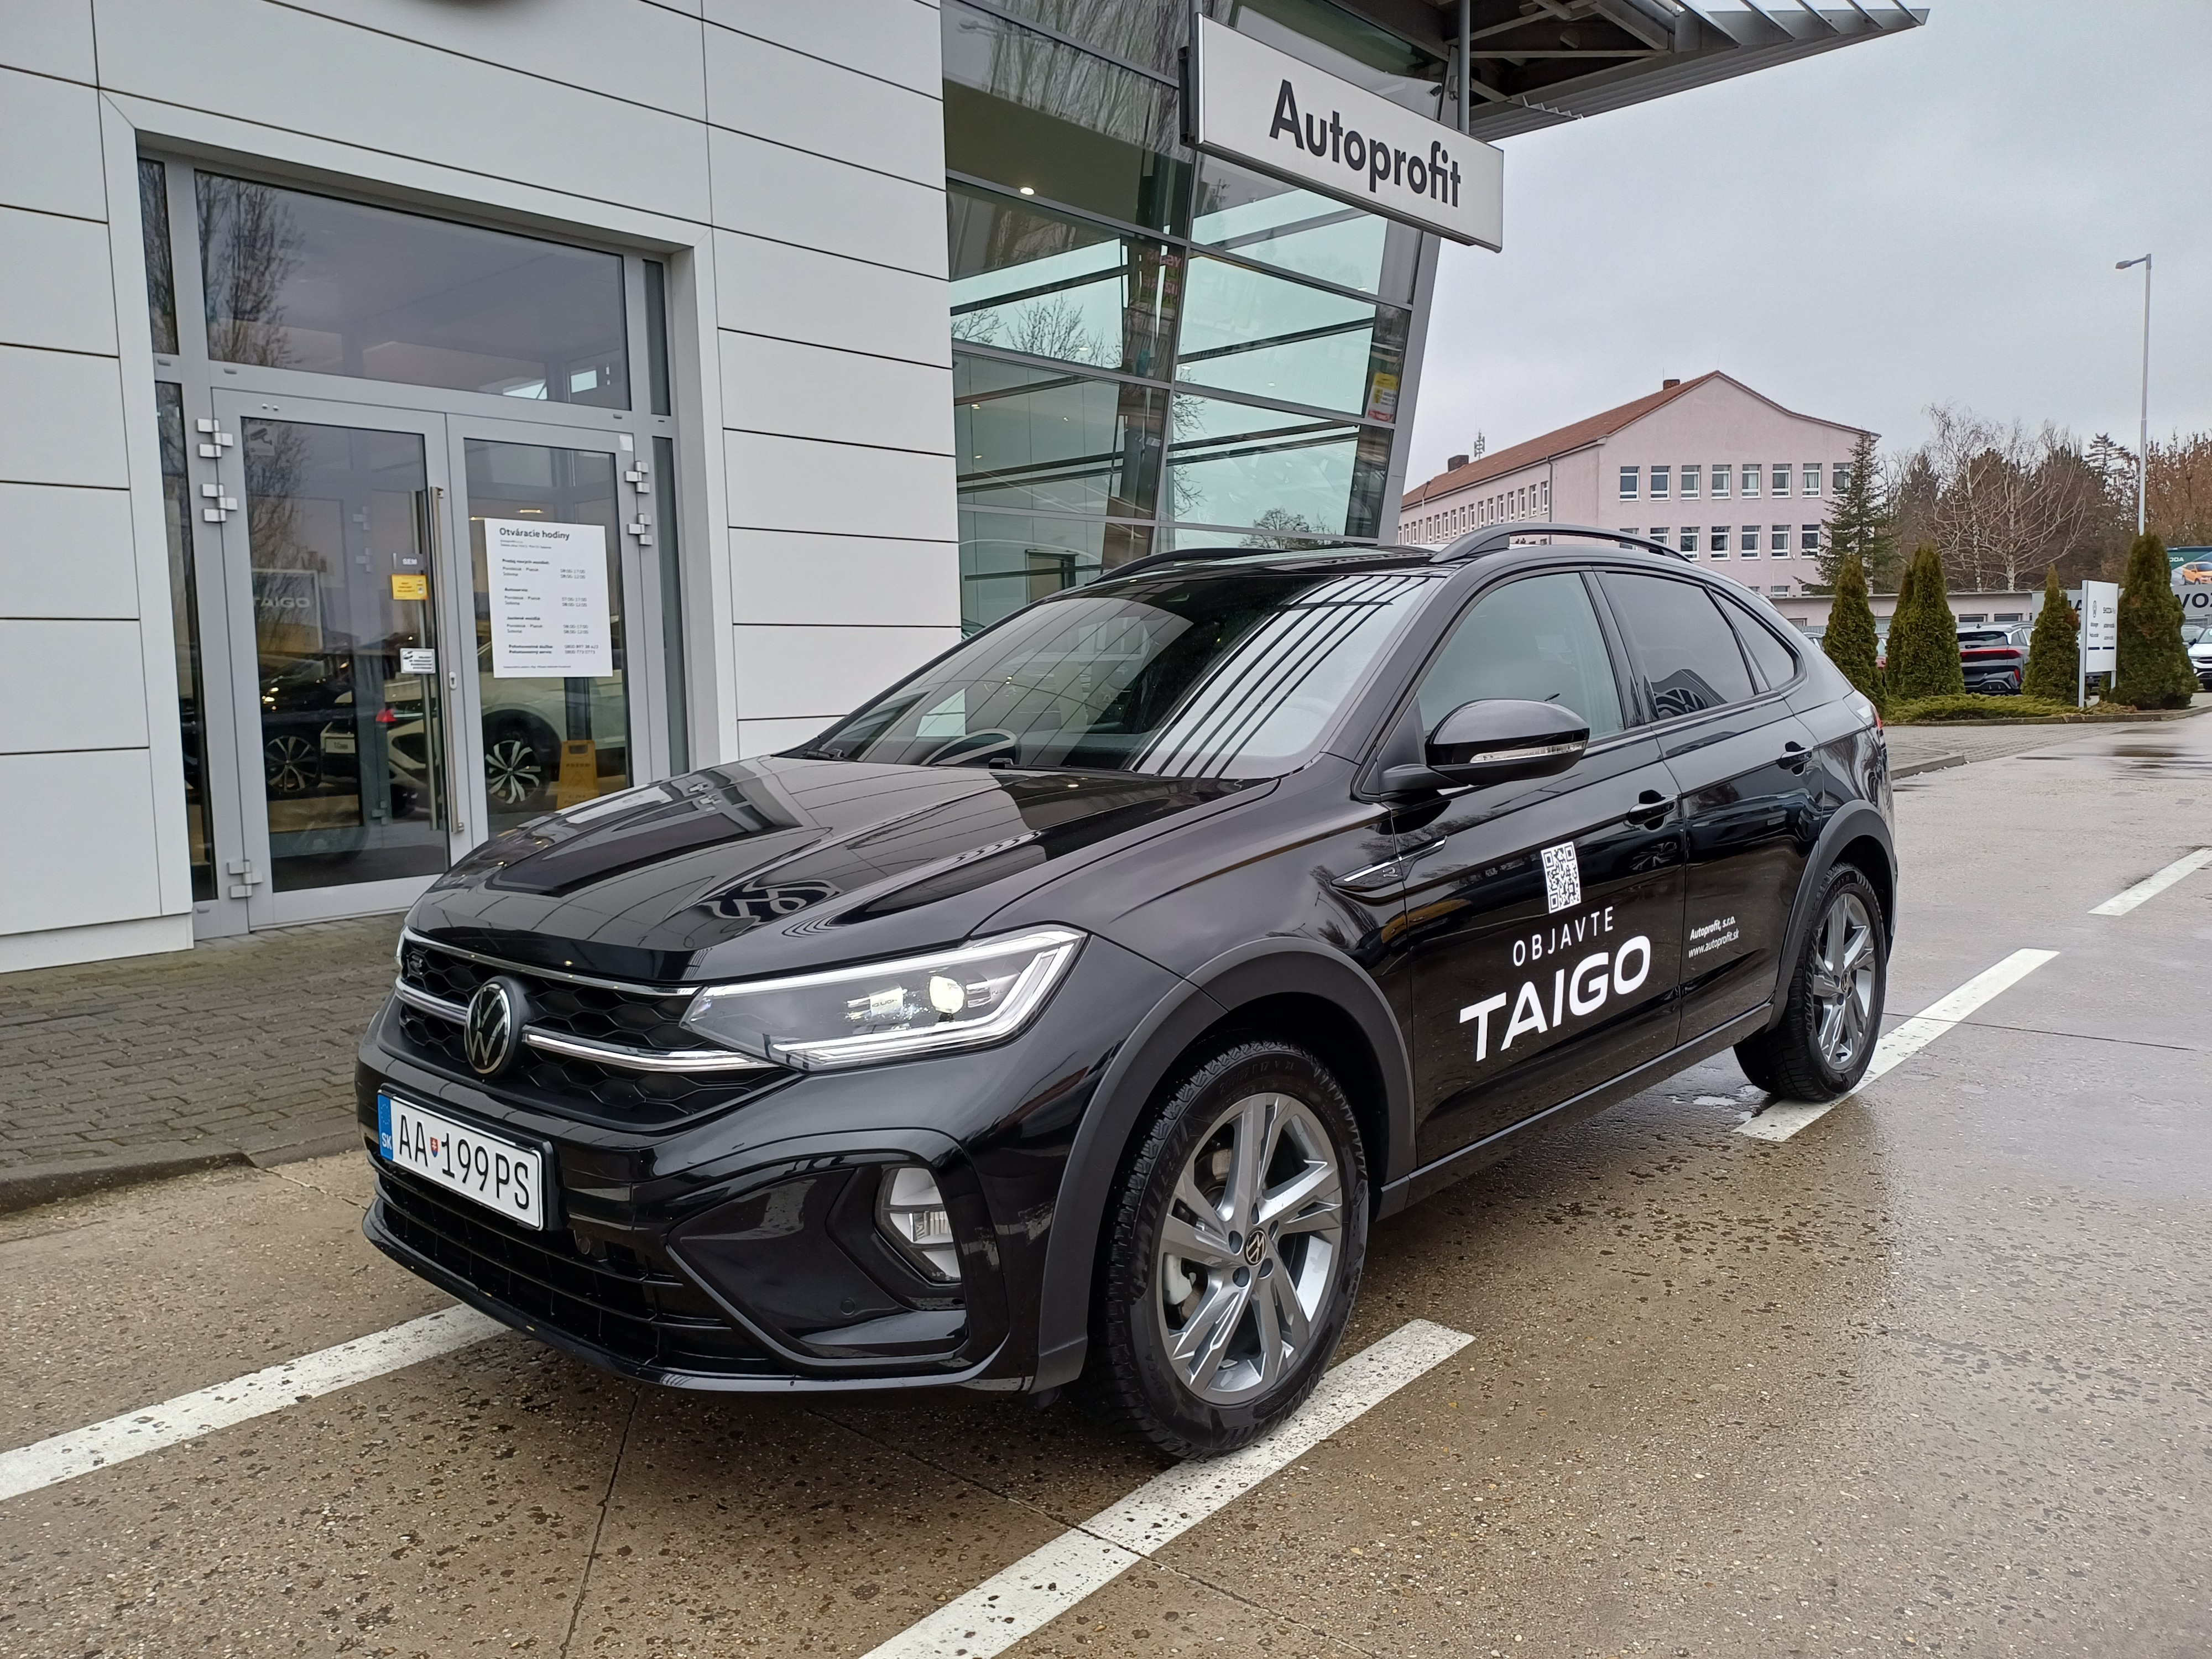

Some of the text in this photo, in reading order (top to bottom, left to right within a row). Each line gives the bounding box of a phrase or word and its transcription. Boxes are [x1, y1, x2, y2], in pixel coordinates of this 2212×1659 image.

[1270, 79, 1461, 208] Autoprofit
[499, 528, 570, 541] Otváracie hodiny
[2175, 593, 2212, 609] VO
[1513, 906, 1613, 967] OBJAVTE
[1688, 927, 1740, 958] www.autoprofit.sk
[1690, 916, 1735, 941] Autoprofit, s.r.o.
[1459, 936, 1651, 1061] TAIGO
[381, 1133, 393, 1151] SK
[399, 1113, 530, 1211] AA 199PS
